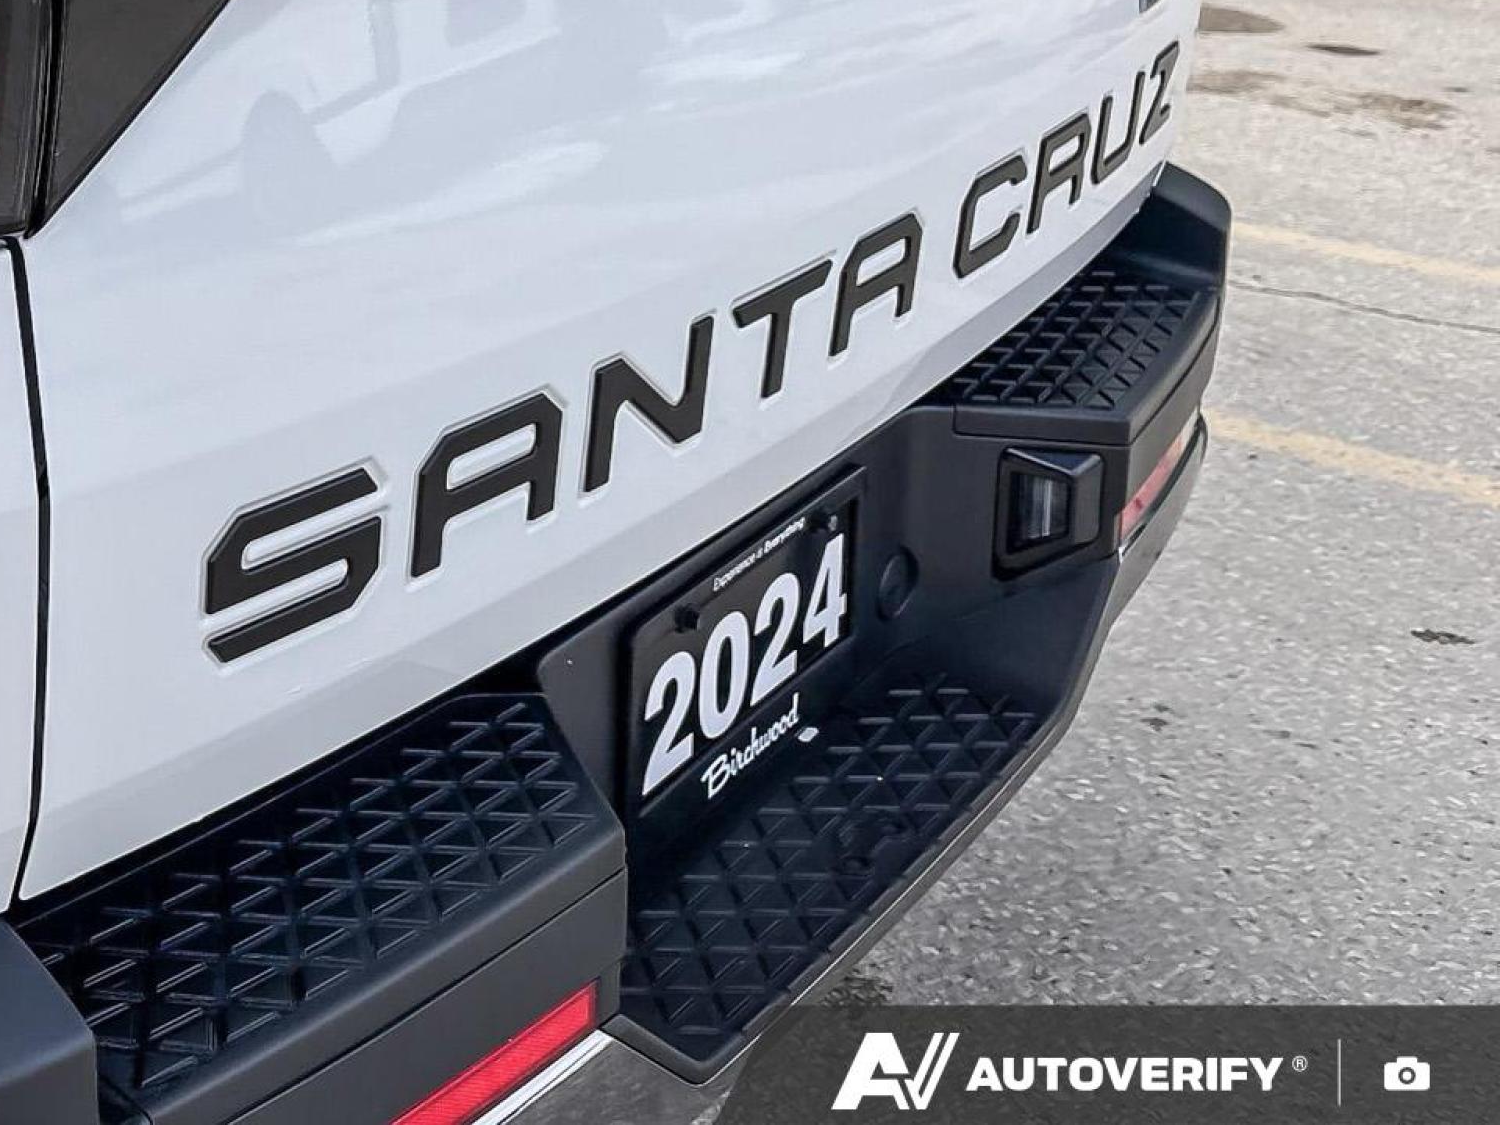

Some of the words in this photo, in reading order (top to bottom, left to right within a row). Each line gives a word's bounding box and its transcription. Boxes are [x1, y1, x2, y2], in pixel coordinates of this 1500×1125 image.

[204, 211, 924, 664] SANTA
[952, 40, 1179, 281] CRUZ
[642, 532, 847, 797] 2024
[700, 693, 800, 800] Birchwood
